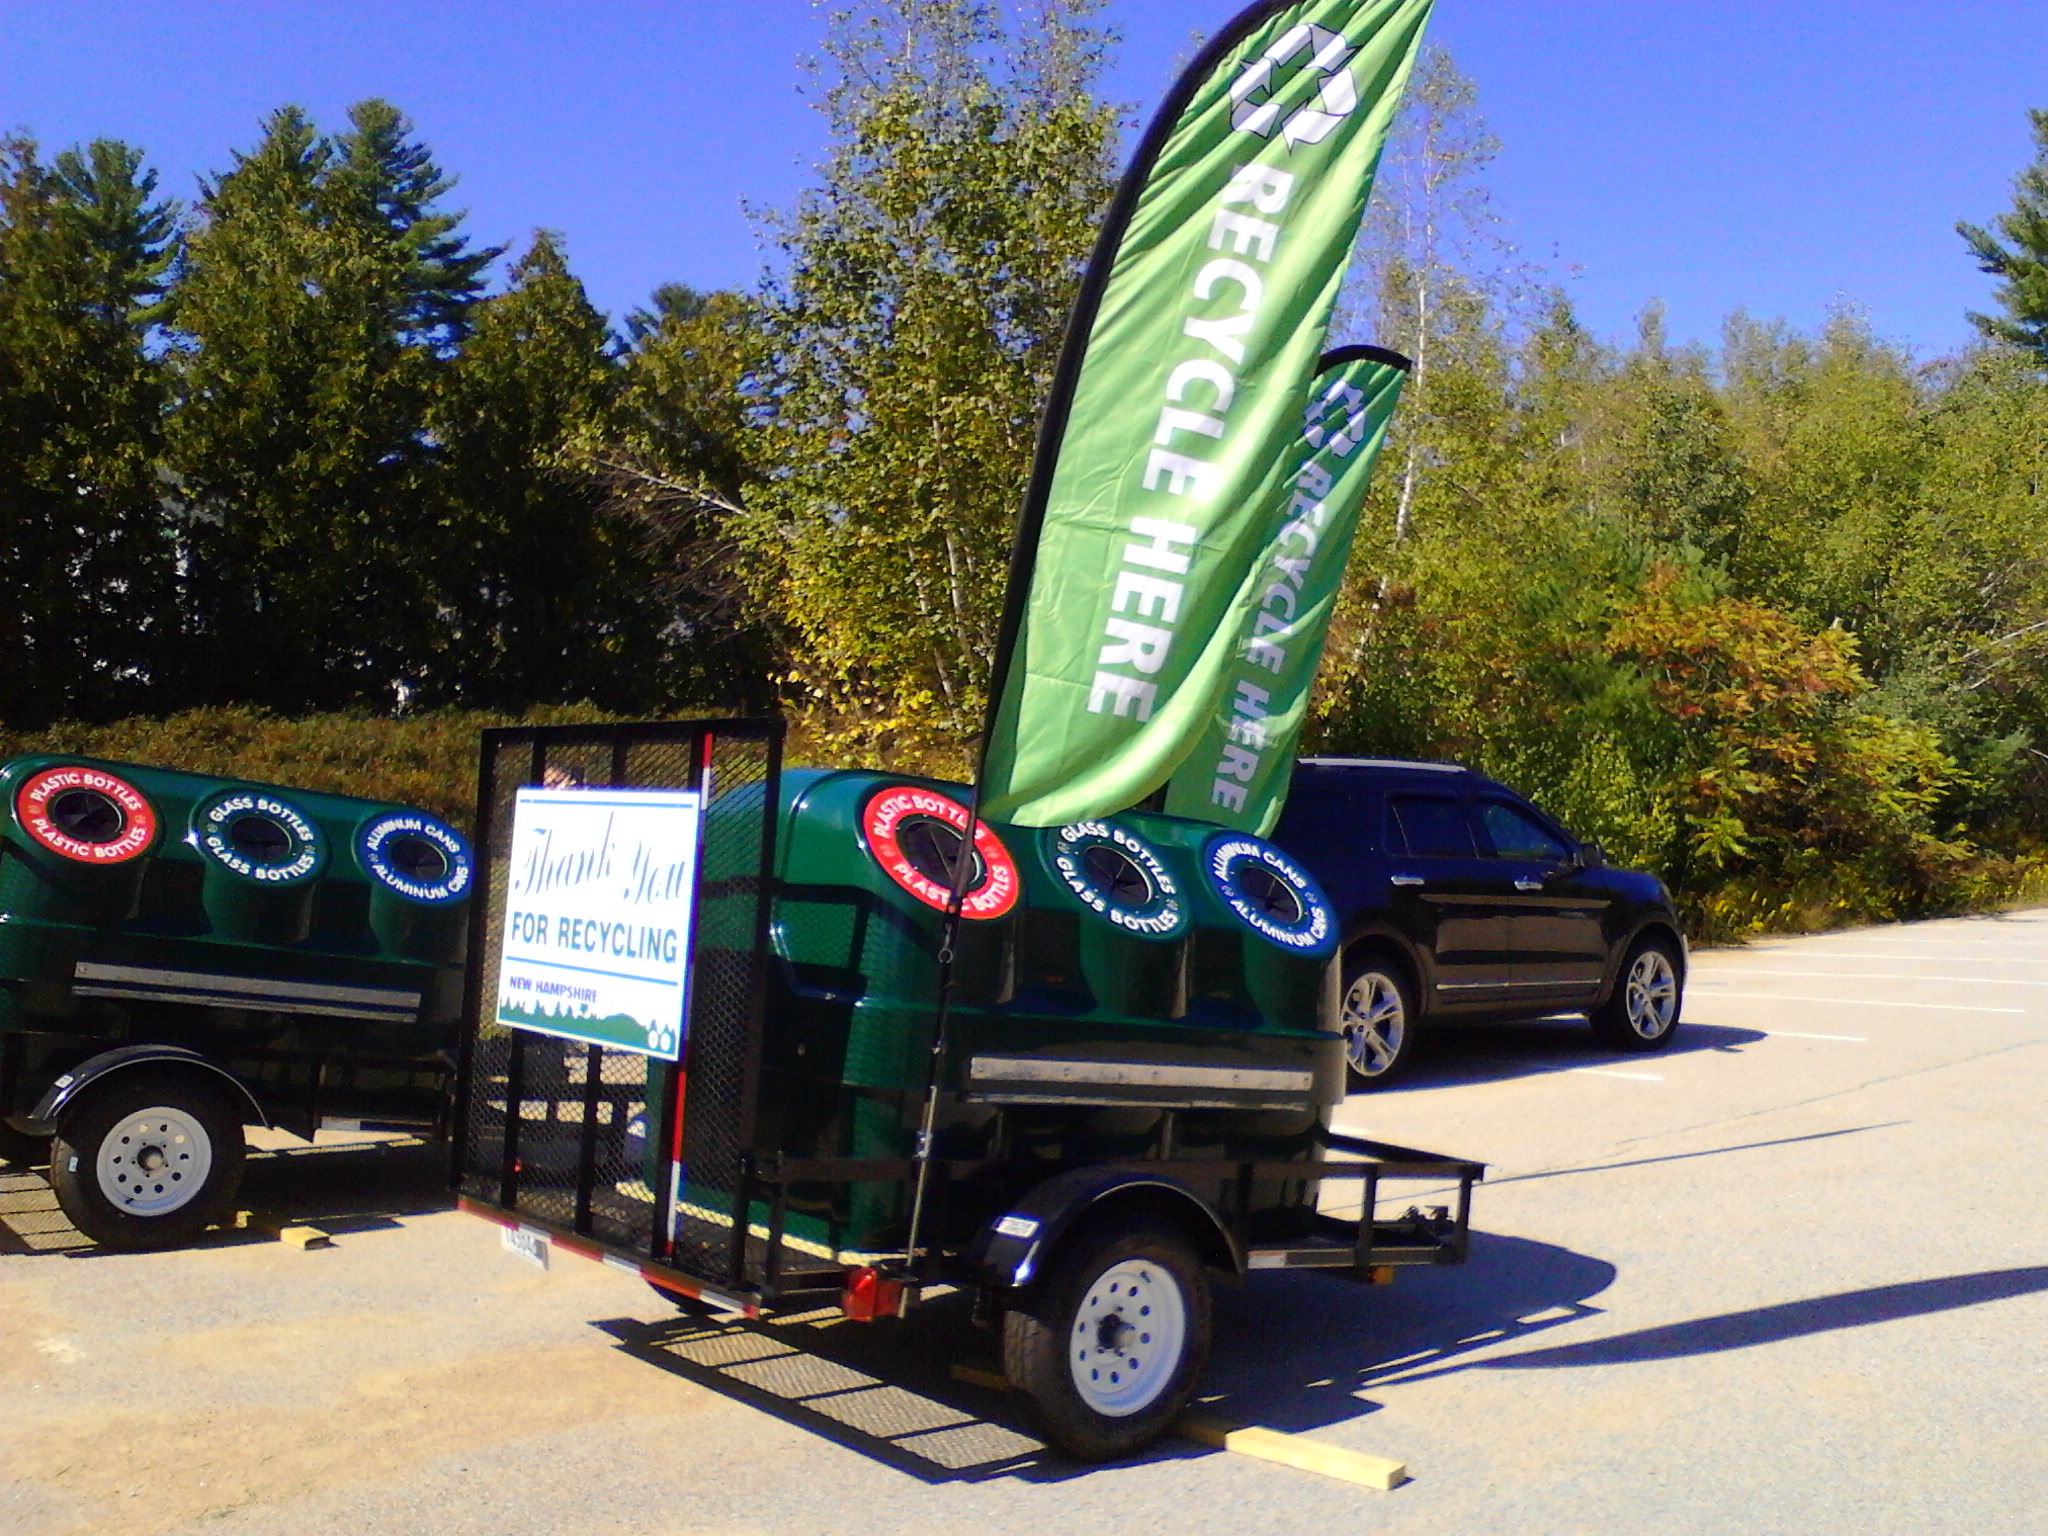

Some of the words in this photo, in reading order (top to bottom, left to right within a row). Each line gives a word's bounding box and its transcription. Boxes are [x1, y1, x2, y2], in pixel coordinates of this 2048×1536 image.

[1142, 163, 1294, 501] RECYCLE
[1246, 459, 1333, 675] RECYCLE
[1087, 516, 1197, 723] HERE
[1211, 679, 1270, 814] HERE
[30, 773, 80, 802] PLASTIC
[84, 774, 142, 811] BOTTLES
[32, 818, 89, 856] PLASTIC
[94, 827, 146, 858] BOTTLES
[209, 797, 253, 822] GLASS
[258, 798, 314, 841] BOTTLES
[367, 818, 421, 851] ALUMINUM
[424, 824, 460, 853] CANS
[874, 795, 912, 838] PLASTIC
[911, 795, 986, 840] BOTTLS
[207, 837, 251, 874] GLASS
[255, 854, 315, 880] BOTTLES
[372, 864, 448, 899] ALUMINUM
[448, 865, 469, 892] CANS
[1061, 822, 1109, 842] GLASS
[1113, 829, 1176, 894] BOTTLES
[1213, 842, 1260, 882] ALUMINUM
[1263, 851, 1307, 888] CANS
[893, 863, 969, 911] PLASTC
[970, 865, 1010, 911] BOTTLES
[1057, 857, 1105, 912] GLASS
[1110, 910, 1178, 933] BOTTLES
[511, 911, 549, 945] FOR
[557, 916, 678, 964] RECYCLING
[1230, 899, 1317, 947] ALUMINUM
[1310, 906, 1327, 939] CANS
[509, 976, 532, 991] NEW
[535, 980, 598, 1003] HAMPSHIRE
